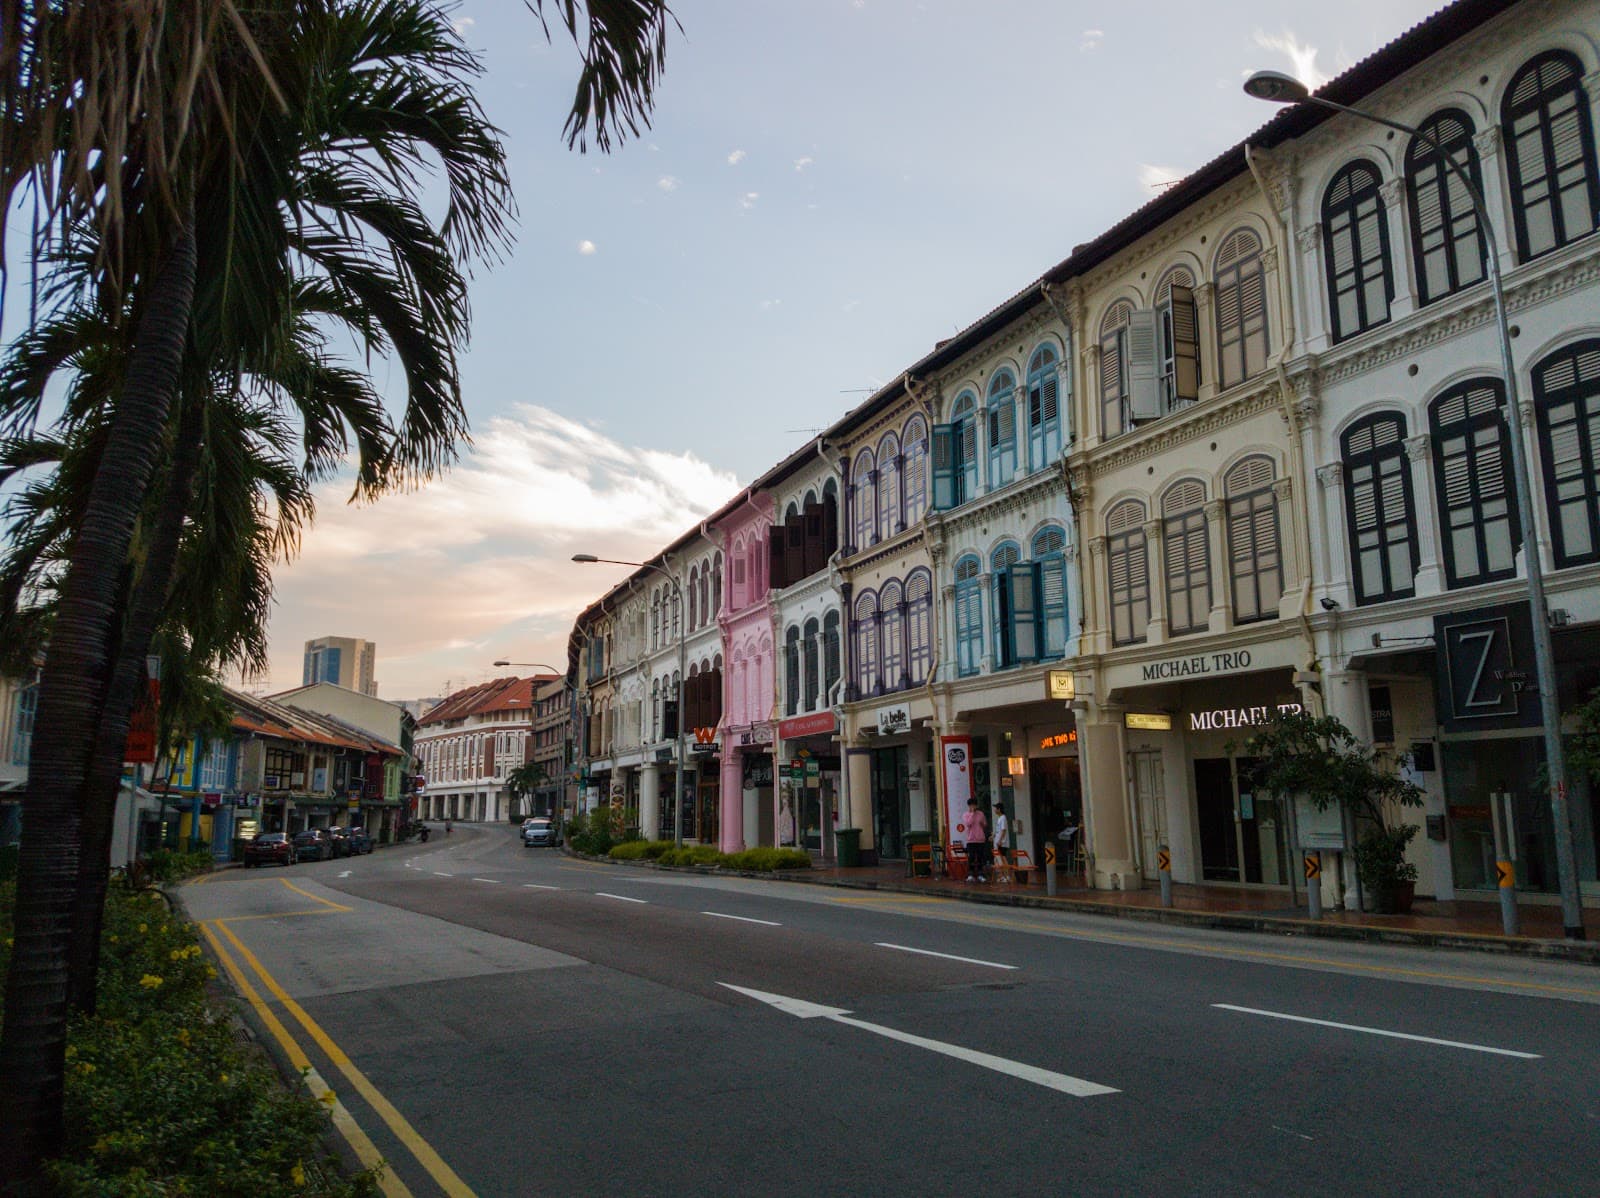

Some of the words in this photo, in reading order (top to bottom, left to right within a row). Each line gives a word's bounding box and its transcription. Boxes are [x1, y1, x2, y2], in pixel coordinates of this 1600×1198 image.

[1143, 657, 1210, 681] MICHAEL
[1213, 651, 1251, 671] TRIO
[1459, 629, 1503, 707] Z
[880, 712, 888, 725] La
[889, 709, 906, 723] belle
[1190, 706, 1275, 731] MICHAEL
[694, 727, 716, 744] W
[1054, 733, 1068, 745] TWO
